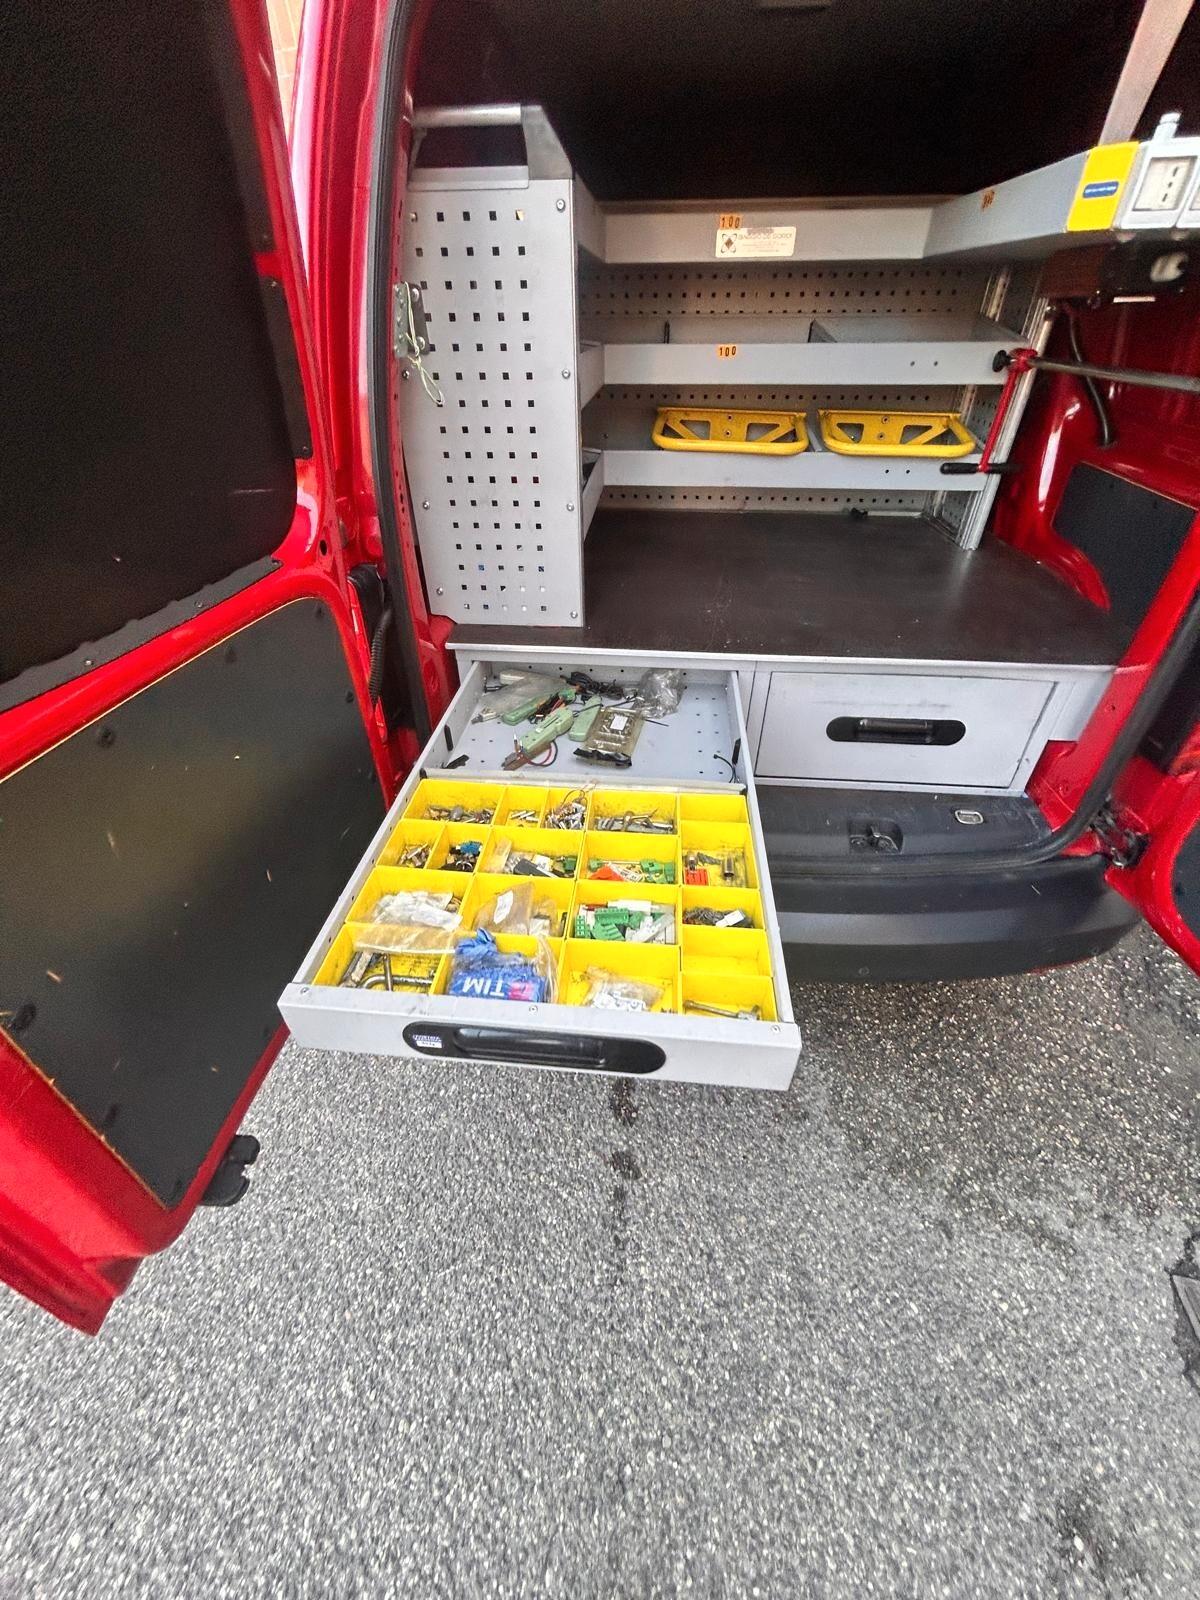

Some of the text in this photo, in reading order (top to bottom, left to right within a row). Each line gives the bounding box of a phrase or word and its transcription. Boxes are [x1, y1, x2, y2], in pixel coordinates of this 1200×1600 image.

[721, 214, 741, 228] 100
[719, 345, 737, 357] 100
[462, 976, 504, 997] TIM
